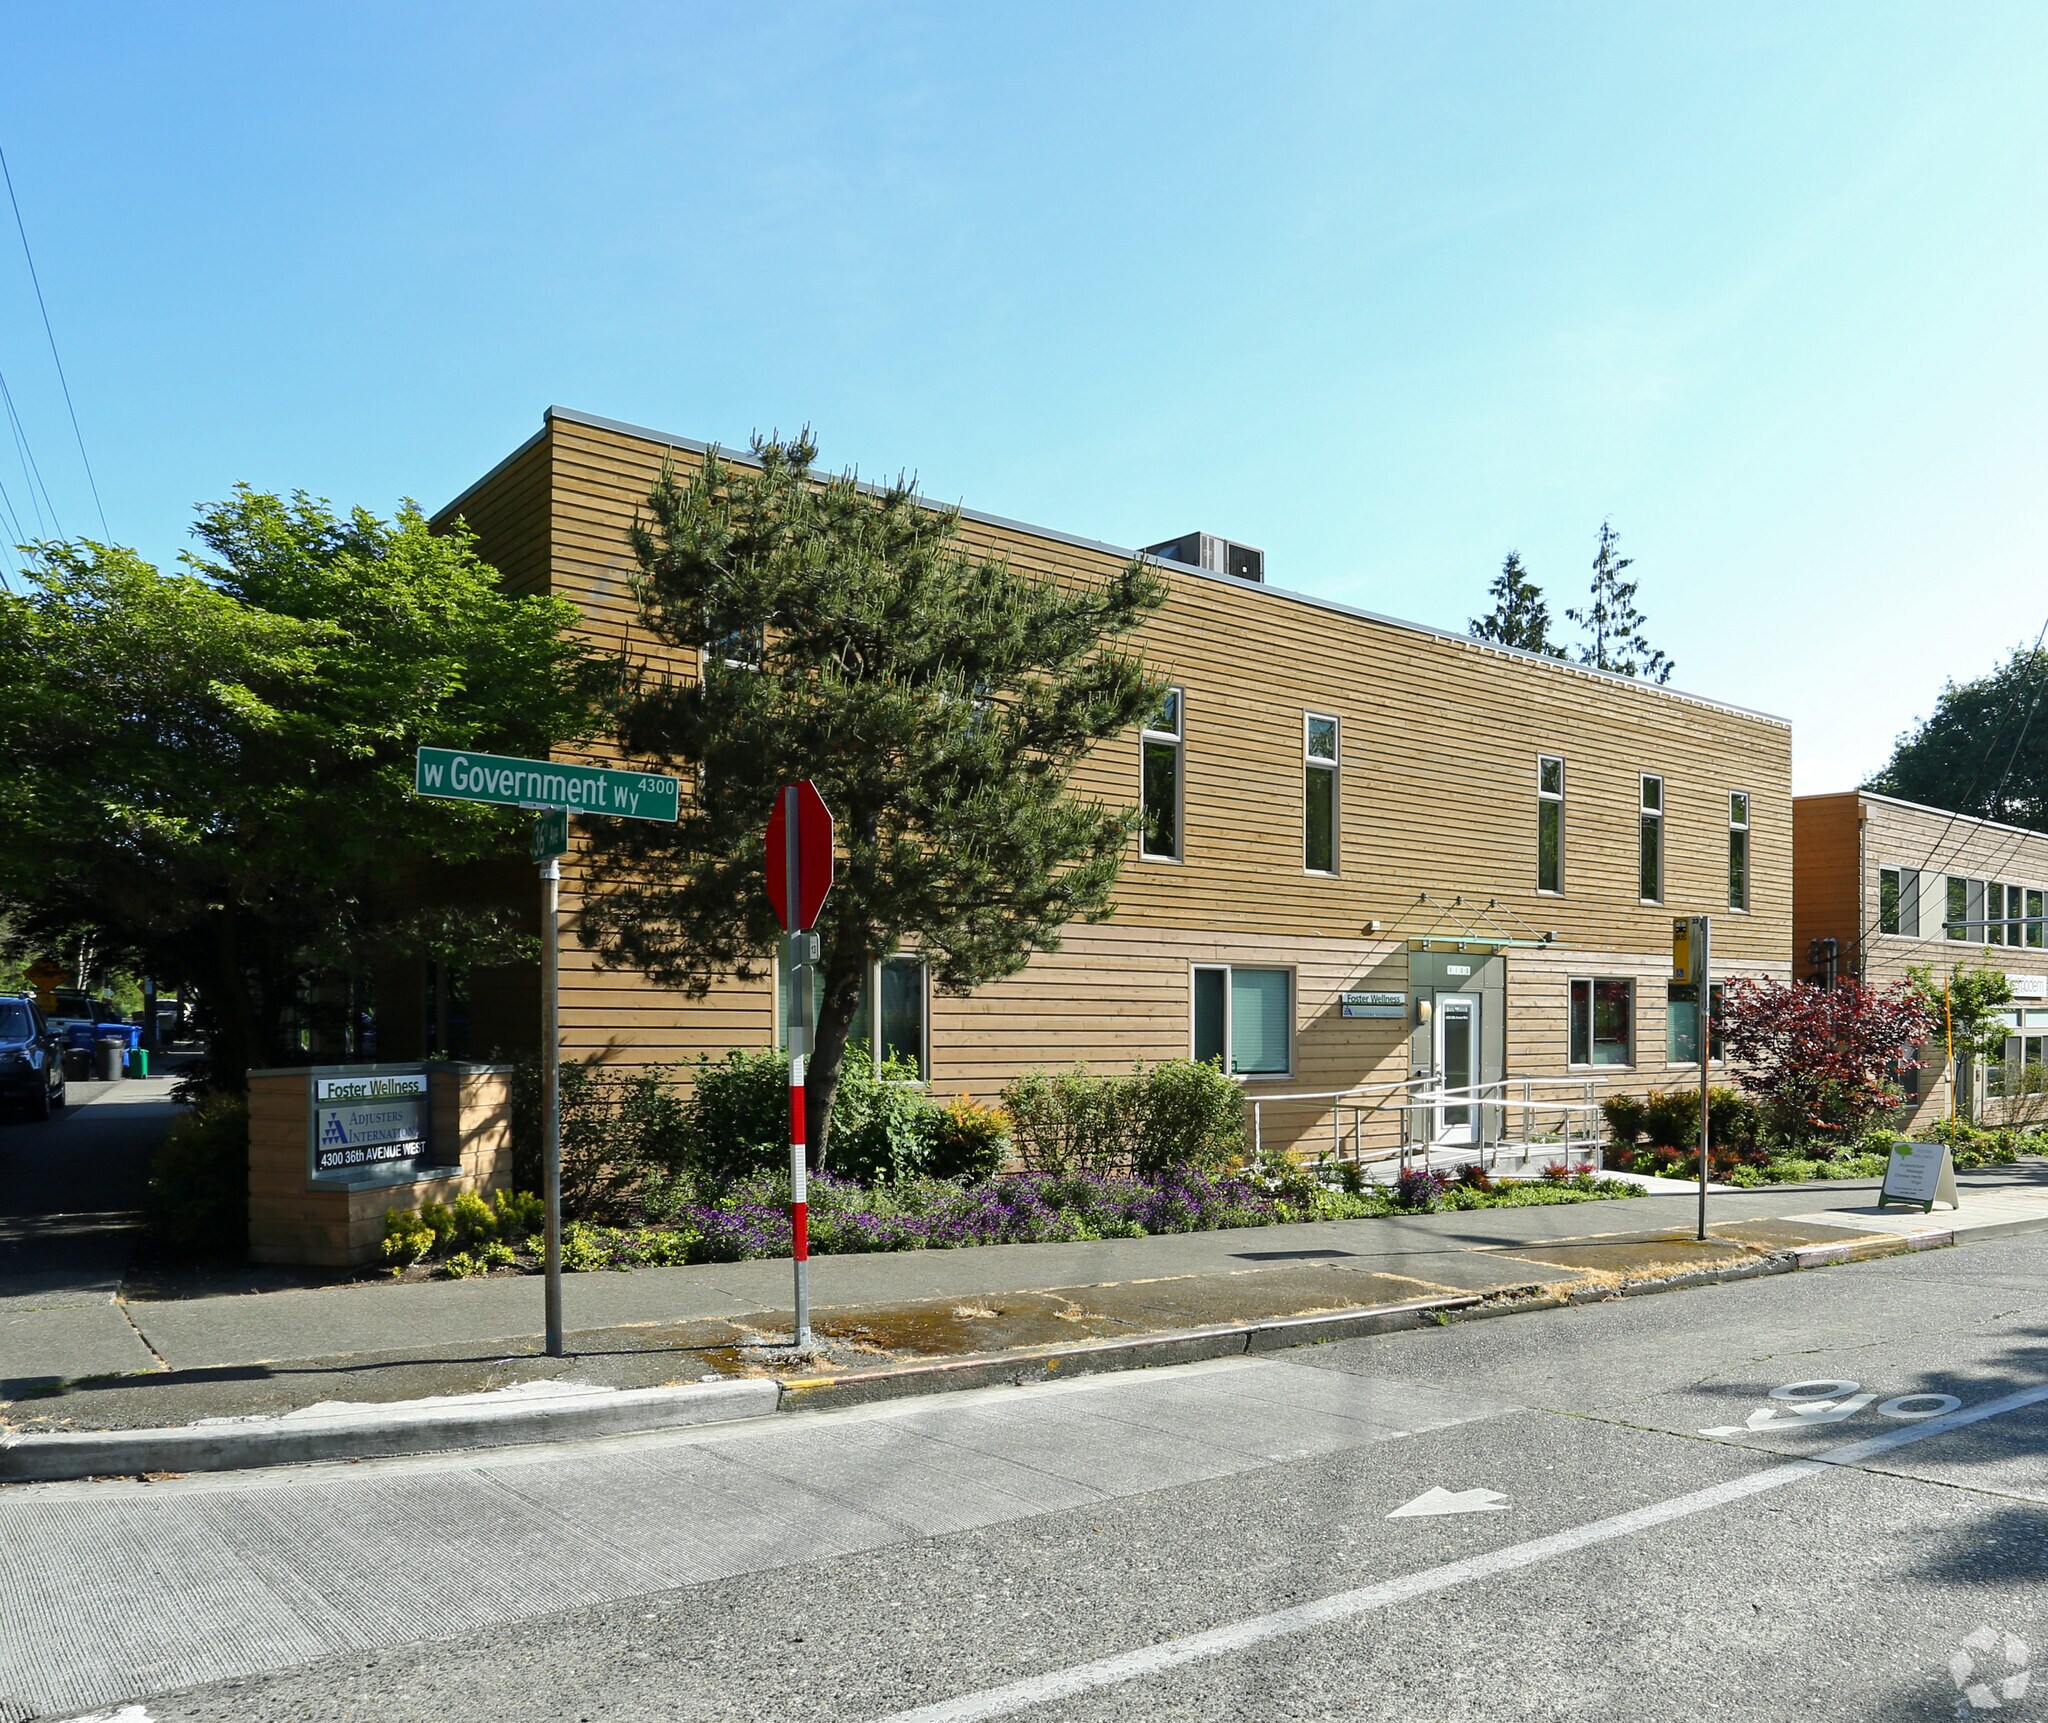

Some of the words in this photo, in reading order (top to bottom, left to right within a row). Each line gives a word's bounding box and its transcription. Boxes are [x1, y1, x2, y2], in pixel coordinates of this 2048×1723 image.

[451, 756, 607, 806] Government
[614, 785, 639, 814] Wy
[638, 778, 674, 795] 4300
[1347, 994, 1369, 1004] Foster
[1371, 994, 1400, 1004] Wellness
[328, 1082, 367, 1098] Foster
[370, 1078, 419, 1096] Wellness
[349, 1111, 403, 1126] ADJUSTERS
[348, 1126, 424, 1144] INTERNATION
[321, 1152, 343, 1167] 4300
[345, 1150, 365, 1163] 36th
[366, 1144, 401, 1160] AVENUE
[402, 1141, 426, 1156] WEST
